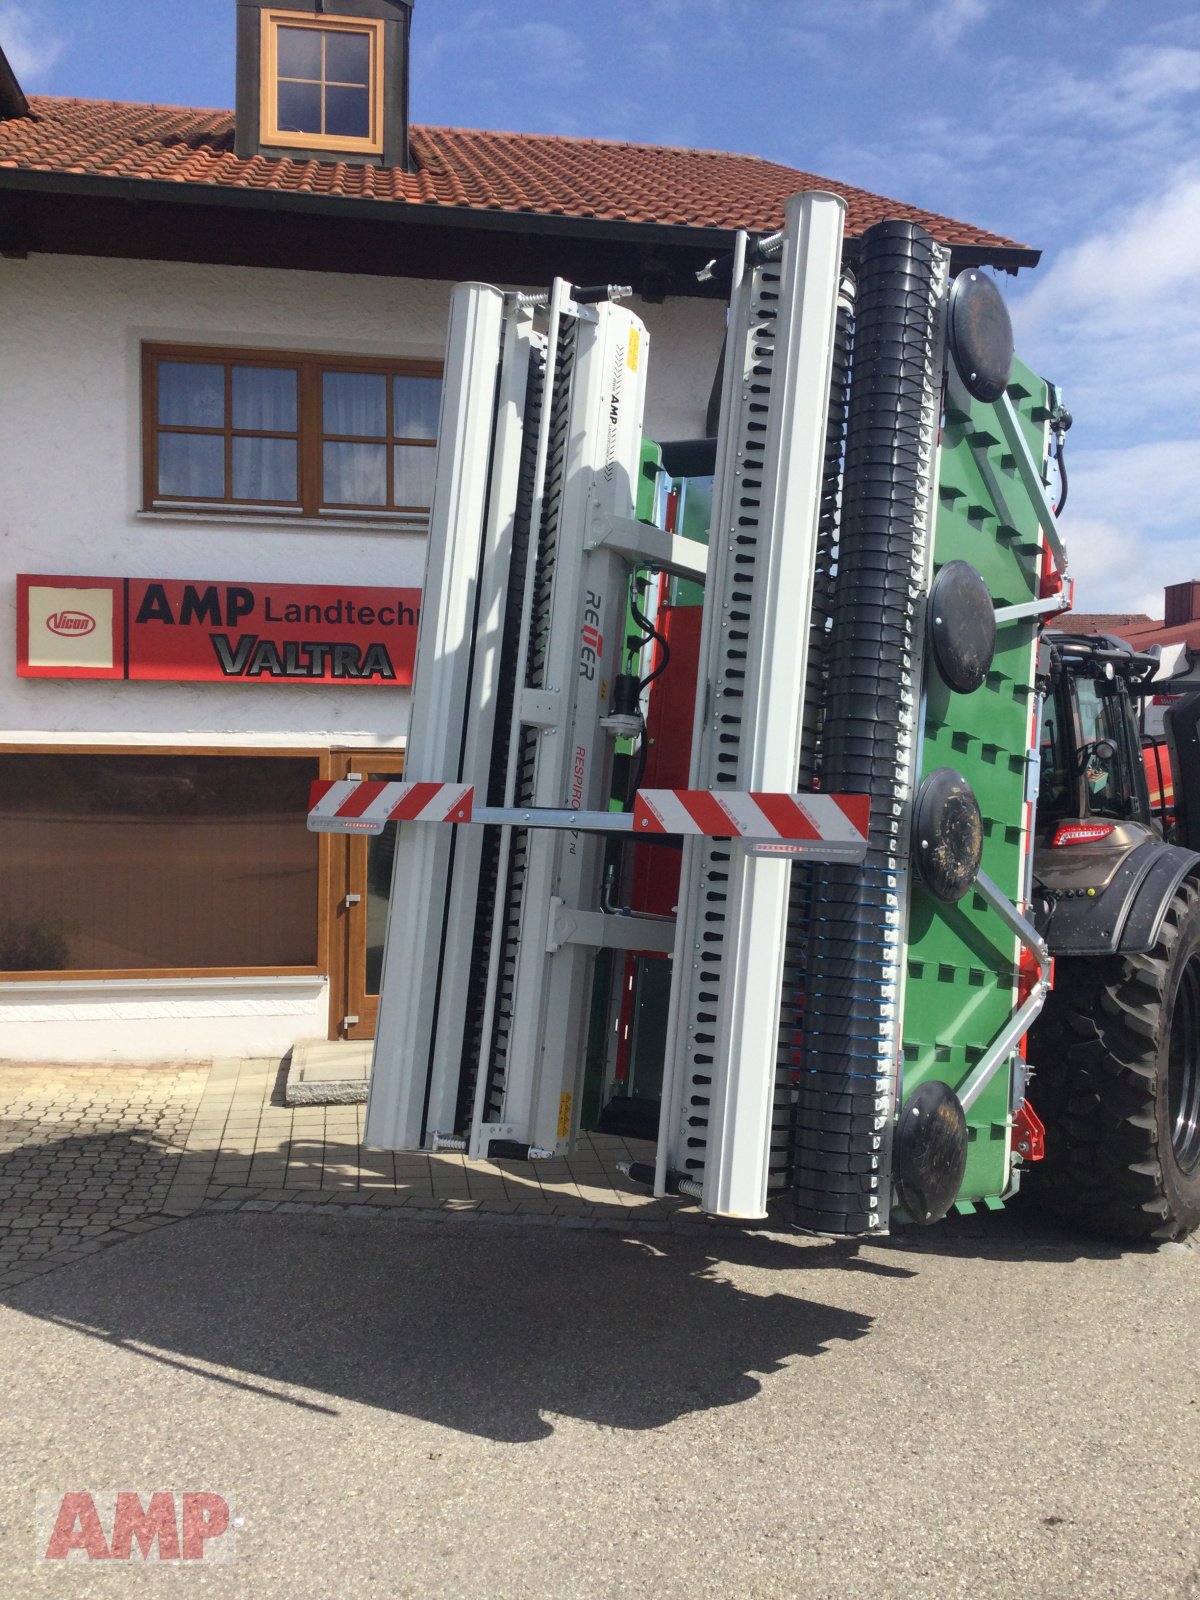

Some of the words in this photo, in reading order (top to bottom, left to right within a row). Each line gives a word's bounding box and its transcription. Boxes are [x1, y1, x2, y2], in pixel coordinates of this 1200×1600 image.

[610, 394, 619, 425] AMP
[53, 612, 89, 630] Vicon
[135, 583, 255, 627] AMP
[208, 633, 397, 679] VALTRA
[570, 745, 586, 809] RESPIRO
